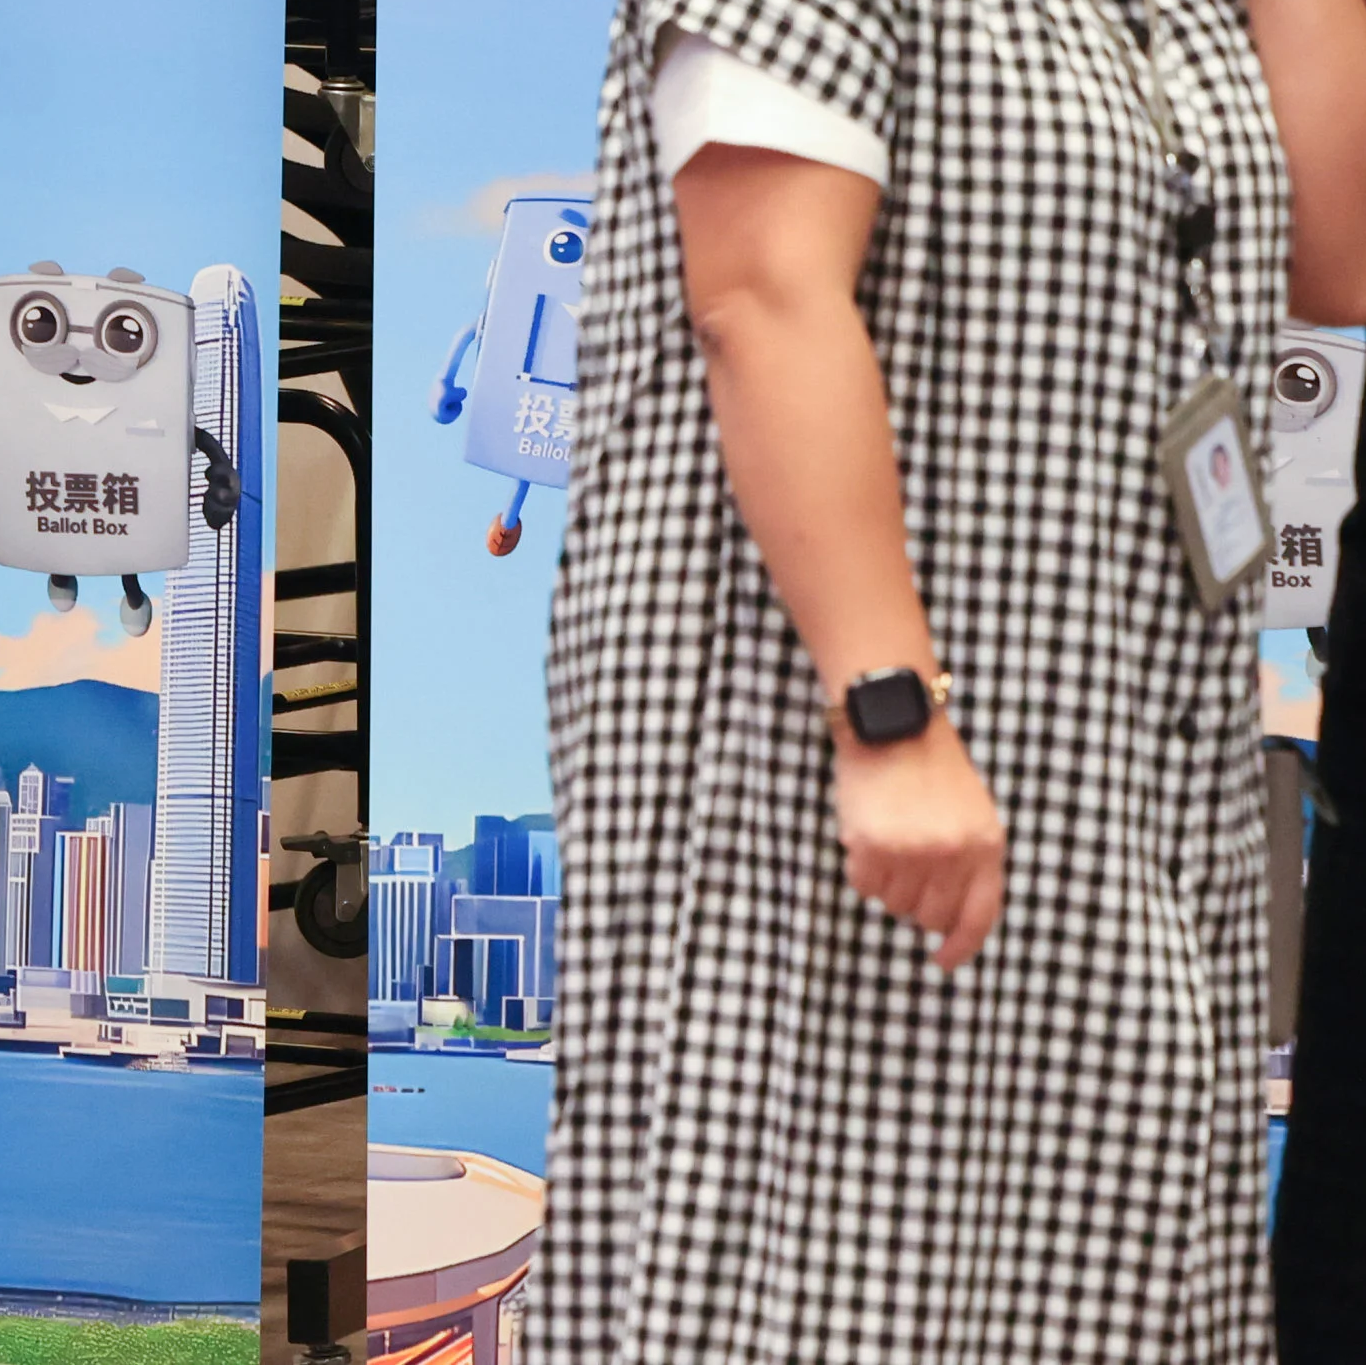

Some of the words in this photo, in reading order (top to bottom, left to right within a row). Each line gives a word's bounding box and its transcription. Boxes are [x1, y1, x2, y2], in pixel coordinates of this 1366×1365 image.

[25, 470, 140, 516] 投票箱
[37, 516, 88, 535] Ballot
[92, 517, 129, 536] Box
[1271, 570, 1312, 588] Box
